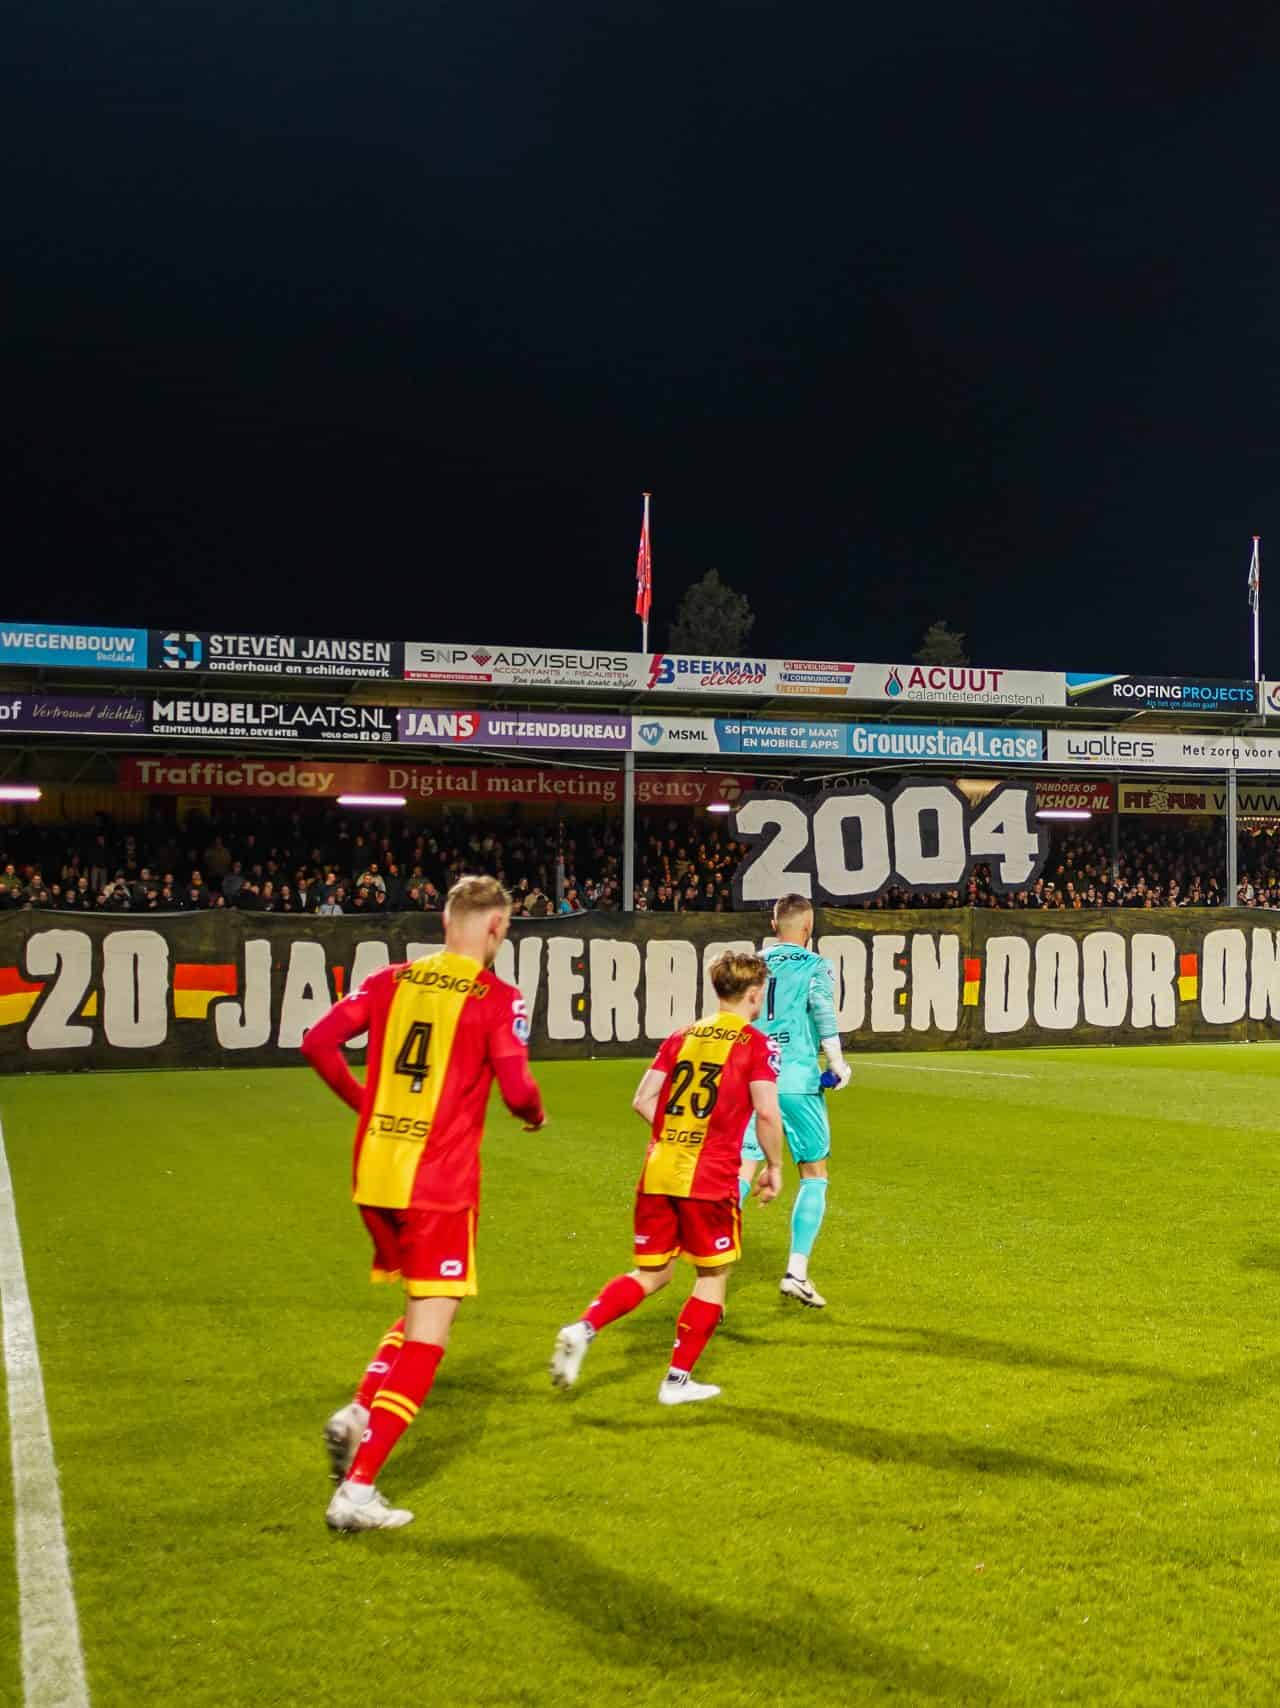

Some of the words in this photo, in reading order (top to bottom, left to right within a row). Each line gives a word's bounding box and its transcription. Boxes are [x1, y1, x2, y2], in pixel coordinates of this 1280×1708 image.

[1, 632, 135, 652] WEGENBOUW
[209, 634, 296, 659] STEVEN
[302, 637, 391, 662] JANSEN
[209, 661, 282, 674] onderhoud
[286, 665, 301, 674] en
[305, 665, 390, 678] schilderwerk
[420, 649, 468, 664] SNP
[493, 653, 628, 671] ADVISEURS
[677, 659, 767, 677] BEEKMAN
[700, 671, 764, 687] elektro
[908, 668, 1004, 692] ACUUT
[907, 689, 1045, 705] calamiteitendiensten.nl
[1113, 684, 1254, 702] ROOFINGPROJECTS
[152, 700, 392, 729] MEUBELPLAATS.NL
[405, 713, 474, 738] JANS
[488, 719, 626, 740] UITZENDBUREAU
[668, 730, 708, 741] MSML
[725, 725, 787, 736] SOFTWARE
[790, 727, 805, 736] OP
[809, 728, 839, 738] MAAT
[743, 738, 758, 747] EN
[760, 739, 808, 749] MOBIELE
[810, 741, 839, 750] APPS
[1067, 735, 1154, 757] wolters
[1183, 744, 1205, 757] Met
[1210, 746, 1240, 760] zorg
[1244, 747, 1273, 758] voor
[136, 760, 334, 792] TrafficToday
[388, 769, 477, 794] Digital
[487, 775, 616, 804] marketing
[1035, 783, 1081, 793] PANDOEK
[1035, 795, 1111, 810] NSHOP.NL
[736, 786, 1039, 901] 2004
[26, 928, 170, 1050] 20
[494, 933, 962, 1042] VERBDEN
[984, 931, 1177, 1033] DOOR
[394, 1020, 433, 1093] 4
[666, 1060, 724, 1119] 23
